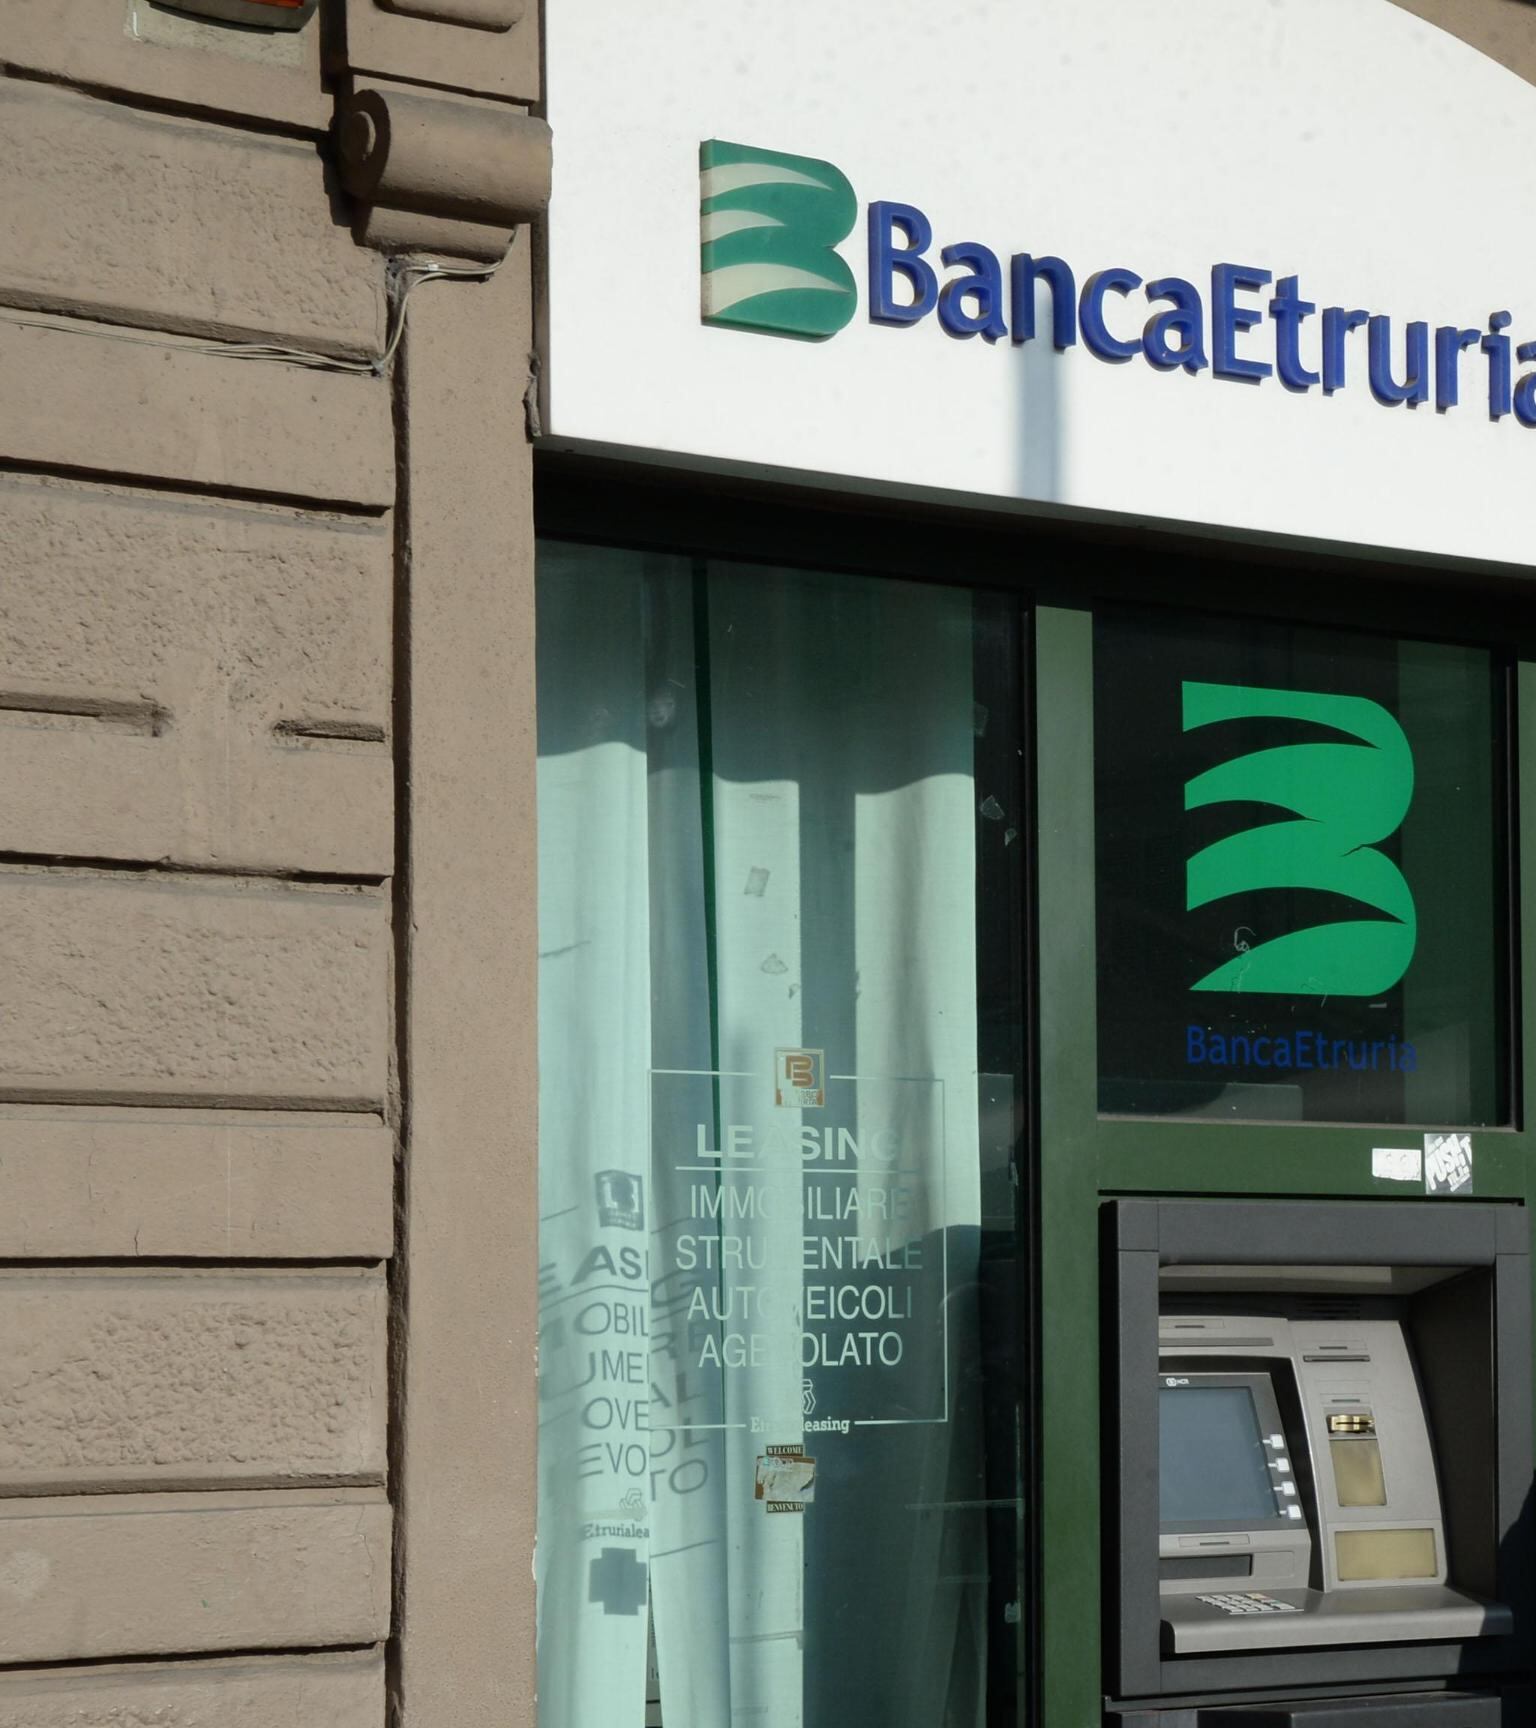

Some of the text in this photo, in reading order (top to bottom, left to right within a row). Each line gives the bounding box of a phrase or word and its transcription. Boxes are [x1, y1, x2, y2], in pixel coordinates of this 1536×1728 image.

[1186, 1025, 1418, 1073] BancaEtruria
[691, 1184, 909, 1220] IMMOILIARE
[675, 1234, 923, 1270] STRUENTALE
[687, 1284, 913, 1320] AUTOEICOLI
[698, 1331, 904, 1368] AGEOLATO
